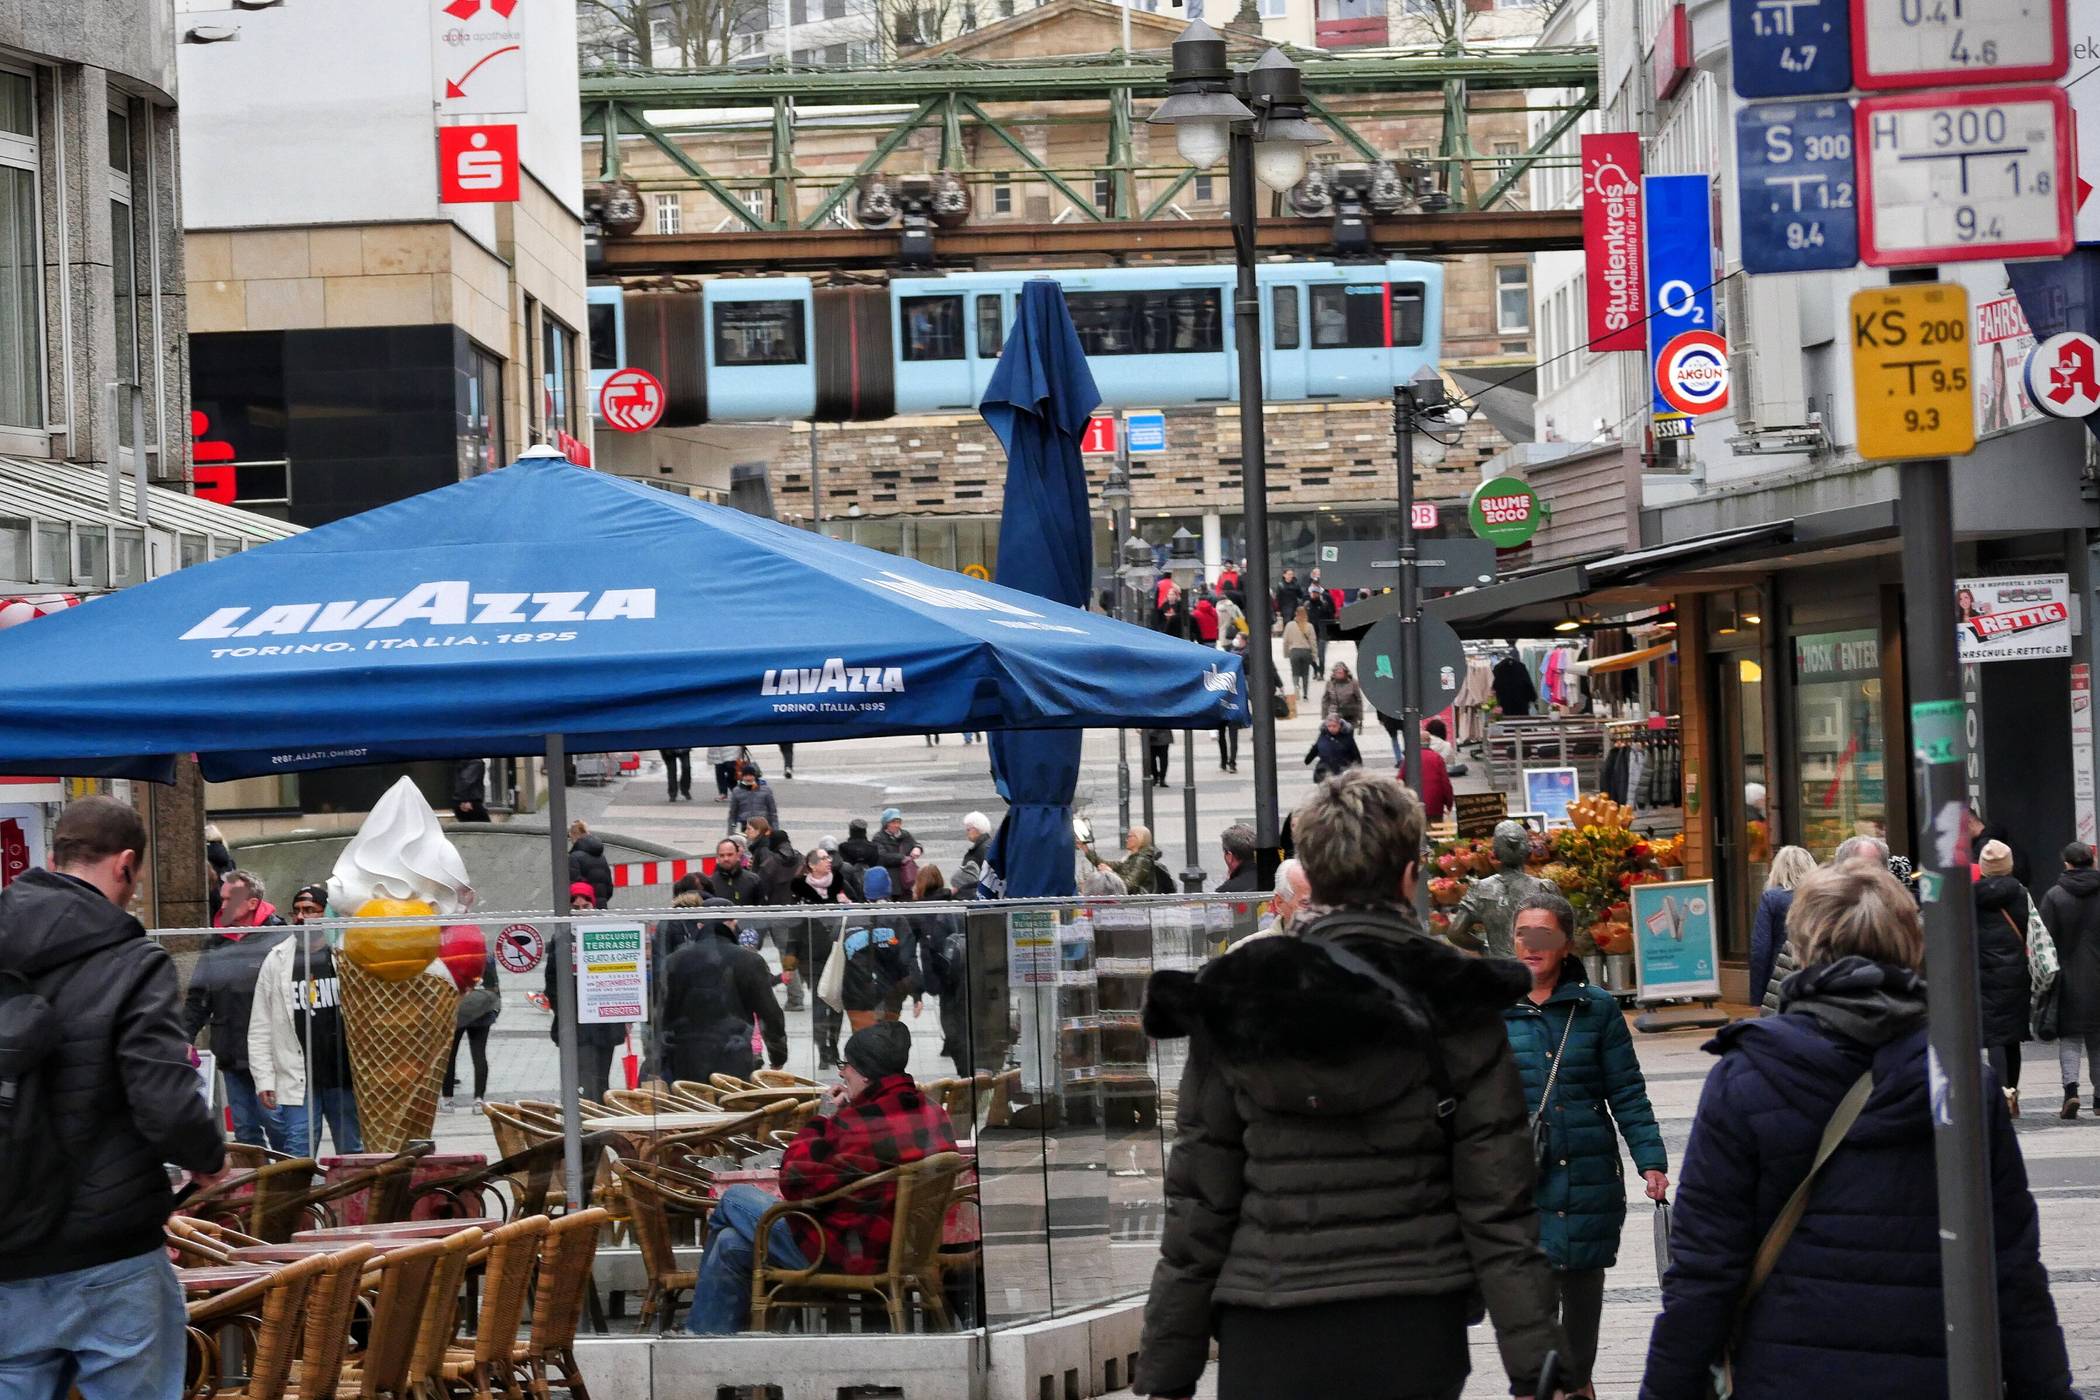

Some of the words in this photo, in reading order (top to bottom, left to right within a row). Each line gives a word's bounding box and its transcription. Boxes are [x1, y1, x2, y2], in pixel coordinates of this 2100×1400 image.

[473, 31, 520, 42] apotheke
[1950, 28, 1998, 66] 4.6
[1780, 45, 1817, 72] 4.7
[1874, 115, 1898, 149] H
[1932, 107, 2006, 147] 300
[1766, 124, 1794, 163] S
[1804, 133, 1851, 161] 300
[2005, 159, 2050, 197] 1.8
[1817, 182, 1853, 209] 1.2
[1786, 222, 1825, 250] 9.4
[1956, 205, 2001, 241] 9.4
[1601, 183, 1629, 331] Studienkreis
[1856, 310, 1907, 348] KS
[1919, 319, 1965, 346] 200
[1931, 367, 1967, 393] 9.5
[1655, 420, 1687, 438] ESSEN
[1904, 408, 1940, 432] 9.3
[1480, 495, 1530, 512] BLUME
[177, 580, 657, 640] LAVAZZA
[1979, 605, 2061, 634] RETTIG
[496, 631, 578, 645] 1895
[1958, 645, 2069, 659] HRSCHULE-RETTIG.DE
[760, 657, 906, 696] LAVAZZA
[860, 702, 886, 711] 1895
[585, 941, 638, 950] TERRASSE
